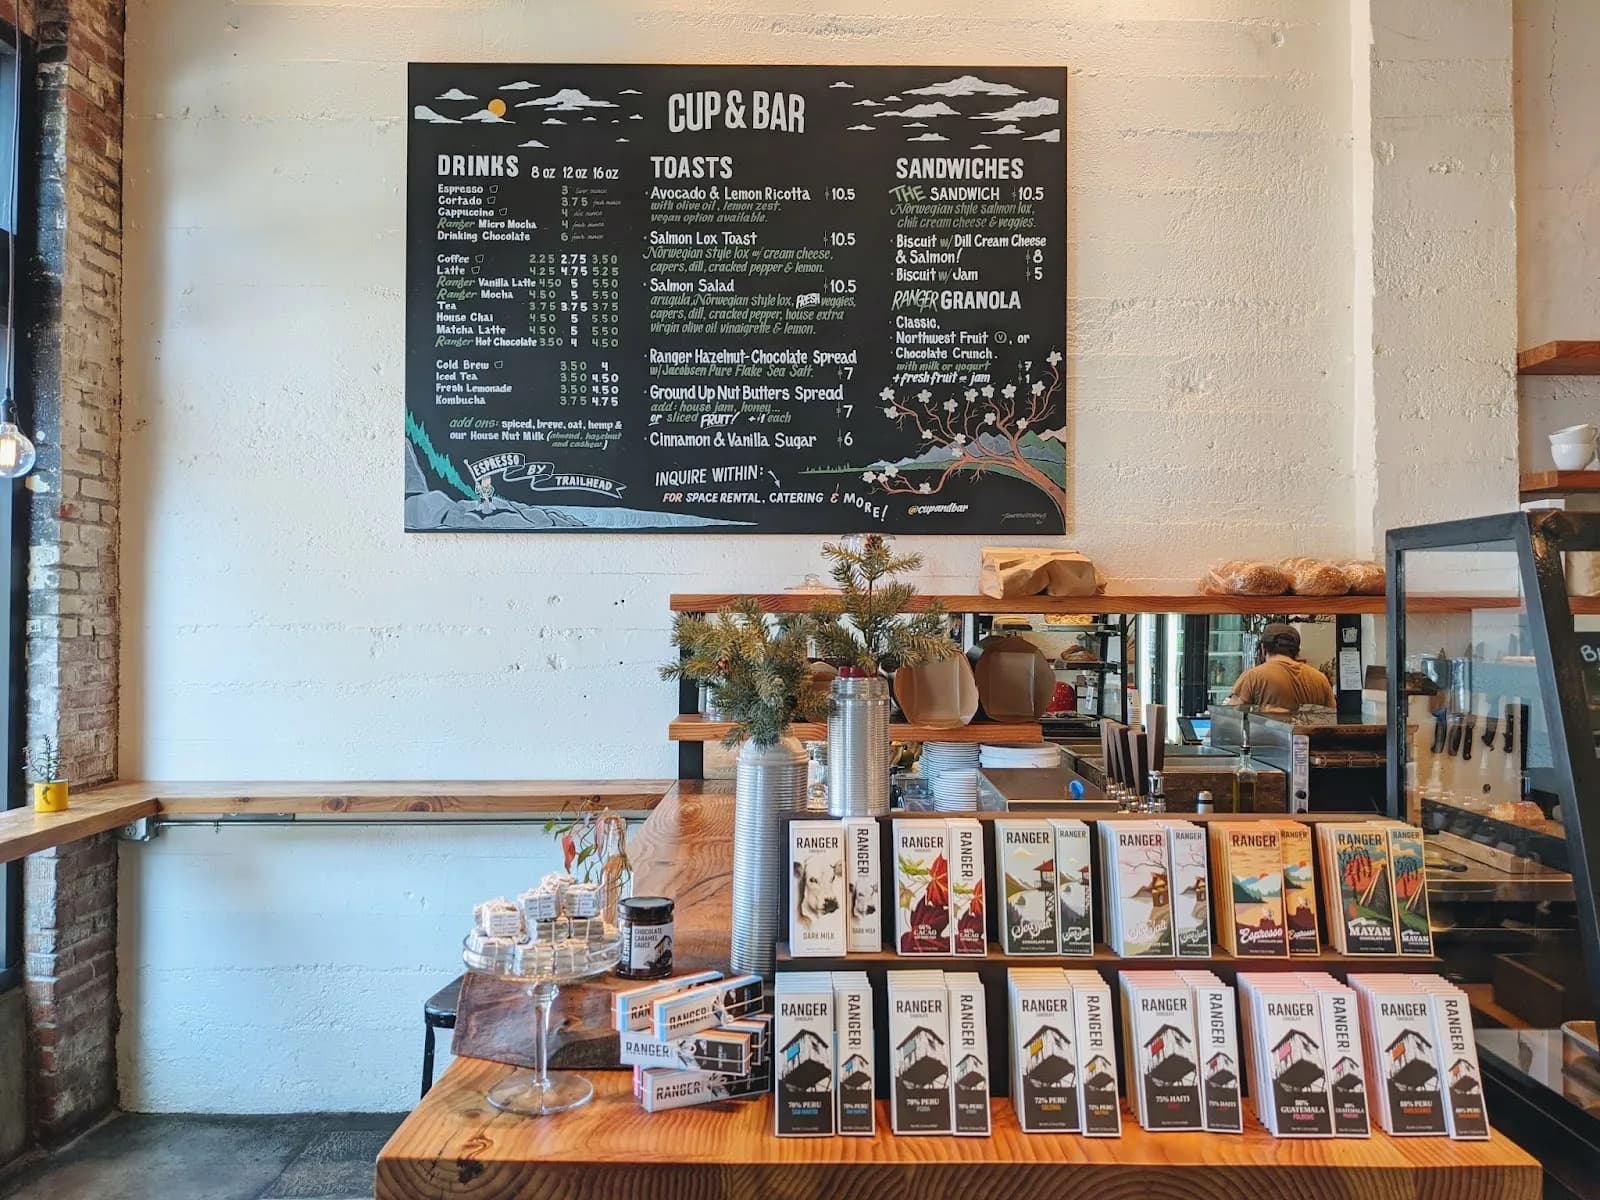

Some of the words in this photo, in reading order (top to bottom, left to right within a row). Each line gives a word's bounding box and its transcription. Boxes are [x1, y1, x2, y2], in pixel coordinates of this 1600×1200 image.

[668, 91, 721, 132] CUP
[725, 89, 747, 129] &
[752, 91, 805, 134] BAR
[438, 155, 519, 177] DRINKS
[650, 156, 733, 179] TOASTS
[896, 158, 1024, 179] SANDWICHES
[437, 184, 484, 194] Espresso
[650, 186, 706, 200] Avocado
[709, 186, 720, 200] &
[724, 186, 762, 200] Lemon
[765, 186, 811, 200] Ricotta
[888, 185, 926, 202] THE
[930, 187, 1000, 200] SANDWICH
[437, 196, 482, 205] Cortado
[675, 201, 700, 211] olive
[723, 201, 753, 211] lemon
[438, 208, 494, 218] Cappuccino
[890, 203, 951, 216] Norwegian
[954, 203, 977, 217] style
[980, 203, 1016, 214] salmon
[437, 218, 475, 230] Ranger
[479, 219, 505, 228] Micro
[507, 219, 537, 228] Mocha
[651, 214, 681, 224] vegan
[683, 213, 714, 224] option
[920, 217, 951, 228] cream
[953, 217, 986, 228] cheese
[437, 231, 477, 242] Drinking
[482, 231, 530, 241] Chocolate
[650, 230, 692, 245] Salmon
[696, 230, 718, 245] Lox
[721, 230, 757, 245] Toast
[896, 234, 937, 247] Biscuit
[954, 234, 972, 247] Dill
[974, 234, 1009, 247] Cream
[1011, 234, 1047, 247] Cheese
[437, 254, 469, 263] Coffee
[560, 254, 587, 264] 2.75
[642, 246, 703, 260] Norwegian
[763, 248, 795, 259] cream
[896, 249, 907, 264] &
[910, 247, 963, 264] Salmon!
[437, 266, 465, 275] Latte
[561, 266, 588, 275] 4.75
[708, 261, 747, 273] cracked
[749, 262, 783, 276] pepper
[896, 267, 937, 281] Biscuit
[953, 267, 978, 281] Jam
[478, 278, 509, 287] Vanilla
[512, 278, 536, 287] Latte
[650, 278, 693, 292] Salmon
[698, 278, 735, 292] Salad
[481, 290, 513, 299] Mocha
[891, 289, 939, 313] RANGER
[940, 290, 1021, 310] GRANOLA
[437, 302, 456, 311] Tea
[560, 302, 588, 312] 3.75
[436, 313, 466, 322] House
[470, 313, 493, 322] Chai
[709, 308, 749, 320] cracked
[785, 308, 813, 320] house
[650, 322, 679, 335] virgin
[682, 322, 703, 334] olive
[705, 322, 717, 334] oil
[720, 322, 770, 336] vinaigrette
[896, 316, 940, 329] Classic,
[436, 325, 473, 334] Matcha
[478, 325, 506, 334] Latte
[475, 338, 491, 346] Hot
[493, 338, 537, 346] Chocolate
[896, 331, 956, 344] Northwest
[960, 331, 989, 344] Fruit
[1017, 334, 1030, 344] or
[650, 348, 692, 366] Ranger
[813, 350, 857, 367] Spread
[896, 347, 948, 359] Chocolate
[436, 360, 460, 370] Cold
[463, 360, 489, 370] Brew
[708, 365, 732, 377] Pure
[767, 365, 785, 377] Sea
[920, 361, 939, 371] milk
[955, 361, 991, 374] yogurt
[436, 372, 457, 381] Iced
[460, 372, 478, 381] Tea
[592, 373, 619, 382] 4.50
[970, 371, 990, 386] jam
[436, 384, 464, 393] Fresh
[466, 384, 512, 393] Lemonade
[592, 385, 619, 394] 4.50
[650, 385, 695, 401] Ground
[699, 385, 721, 403] Up
[724, 385, 739, 401] Nut
[742, 385, 789, 401] Butters
[795, 384, 843, 403] Spread
[436, 396, 486, 405] Kombucha
[592, 397, 619, 407] 4.75
[679, 402, 711, 412] house
[501, 419, 536, 430] spiced,
[588, 420, 614, 431] hemp
[666, 412, 699, 423] sliced
[700, 411, 740, 428] FRUIT!
[767, 412, 791, 423] each
[450, 432, 467, 440] our
[470, 431, 499, 440] House
[501, 431, 520, 440] Nut
[523, 431, 544, 440] Milk
[650, 432, 711, 447] Cinnamon
[714, 432, 725, 447] &
[728, 432, 770, 447] Vanilla
[775, 432, 816, 450] Sugar
[473, 455, 519, 477] ESPRESSO
[526, 465, 547, 475] BY
[555, 476, 613, 490] TRAILHEAD
[655, 468, 706, 487] INQUIRE
[711, 465, 764, 482] WITHIN:
[663, 493, 682, 503] FOR
[685, 492, 718, 503] SPACE
[769, 492, 824, 503] CATERING
[843, 493, 888, 521] MORE!
[908, 503, 968, 515] @cupandbar
[1006, 831, 1049, 844] RANGER
[1060, 829, 1087, 839] RANGER
[1120, 834, 1162, 847] RANGER
[1175, 831, 1202, 840] RANGER
[1337, 833, 1382, 846] RANGER
[1392, 831, 1420, 840] RANGER
[797, 837, 838, 849] RANGER
[902, 836, 944, 848] RANGER
[1231, 834, 1276, 848] RANGER
[857, 828, 869, 875] RANGER
[960, 832, 974, 878] RANGER
[803, 932, 819, 940] DARK
[820, 932, 835, 940] MILK
[1240, 927, 1283, 944] Espresso
[1350, 927, 1391, 937] MAYAN
[1402, 934, 1429, 943] MAYAN
[781, 1002, 827, 1017] RANGER
[896, 999, 942, 1013] RANGER
[1022, 999, 1067, 1012] RANGER
[1142, 998, 1187, 1011] RANGER
[1268, 1003, 1314, 1016] RANGER
[1381, 1003, 1427, 1016] RANGER
[848, 995, 861, 1050] RANGER
[960, 994, 975, 1047] RANGER
[1086, 995, 1103, 1047] RANGER
[1209, 993, 1225, 1044] RANGER
[1332, 997, 1350, 1050] RANGER
[1445, 1000, 1465, 1051] RANGER
[625, 1041, 669, 1058] RANGER
[802, 1101, 821, 1109] PERU
[1170, 1095, 1190, 1103] HAITI
[1280, 1105, 1325, 1114] GUATEMALA
